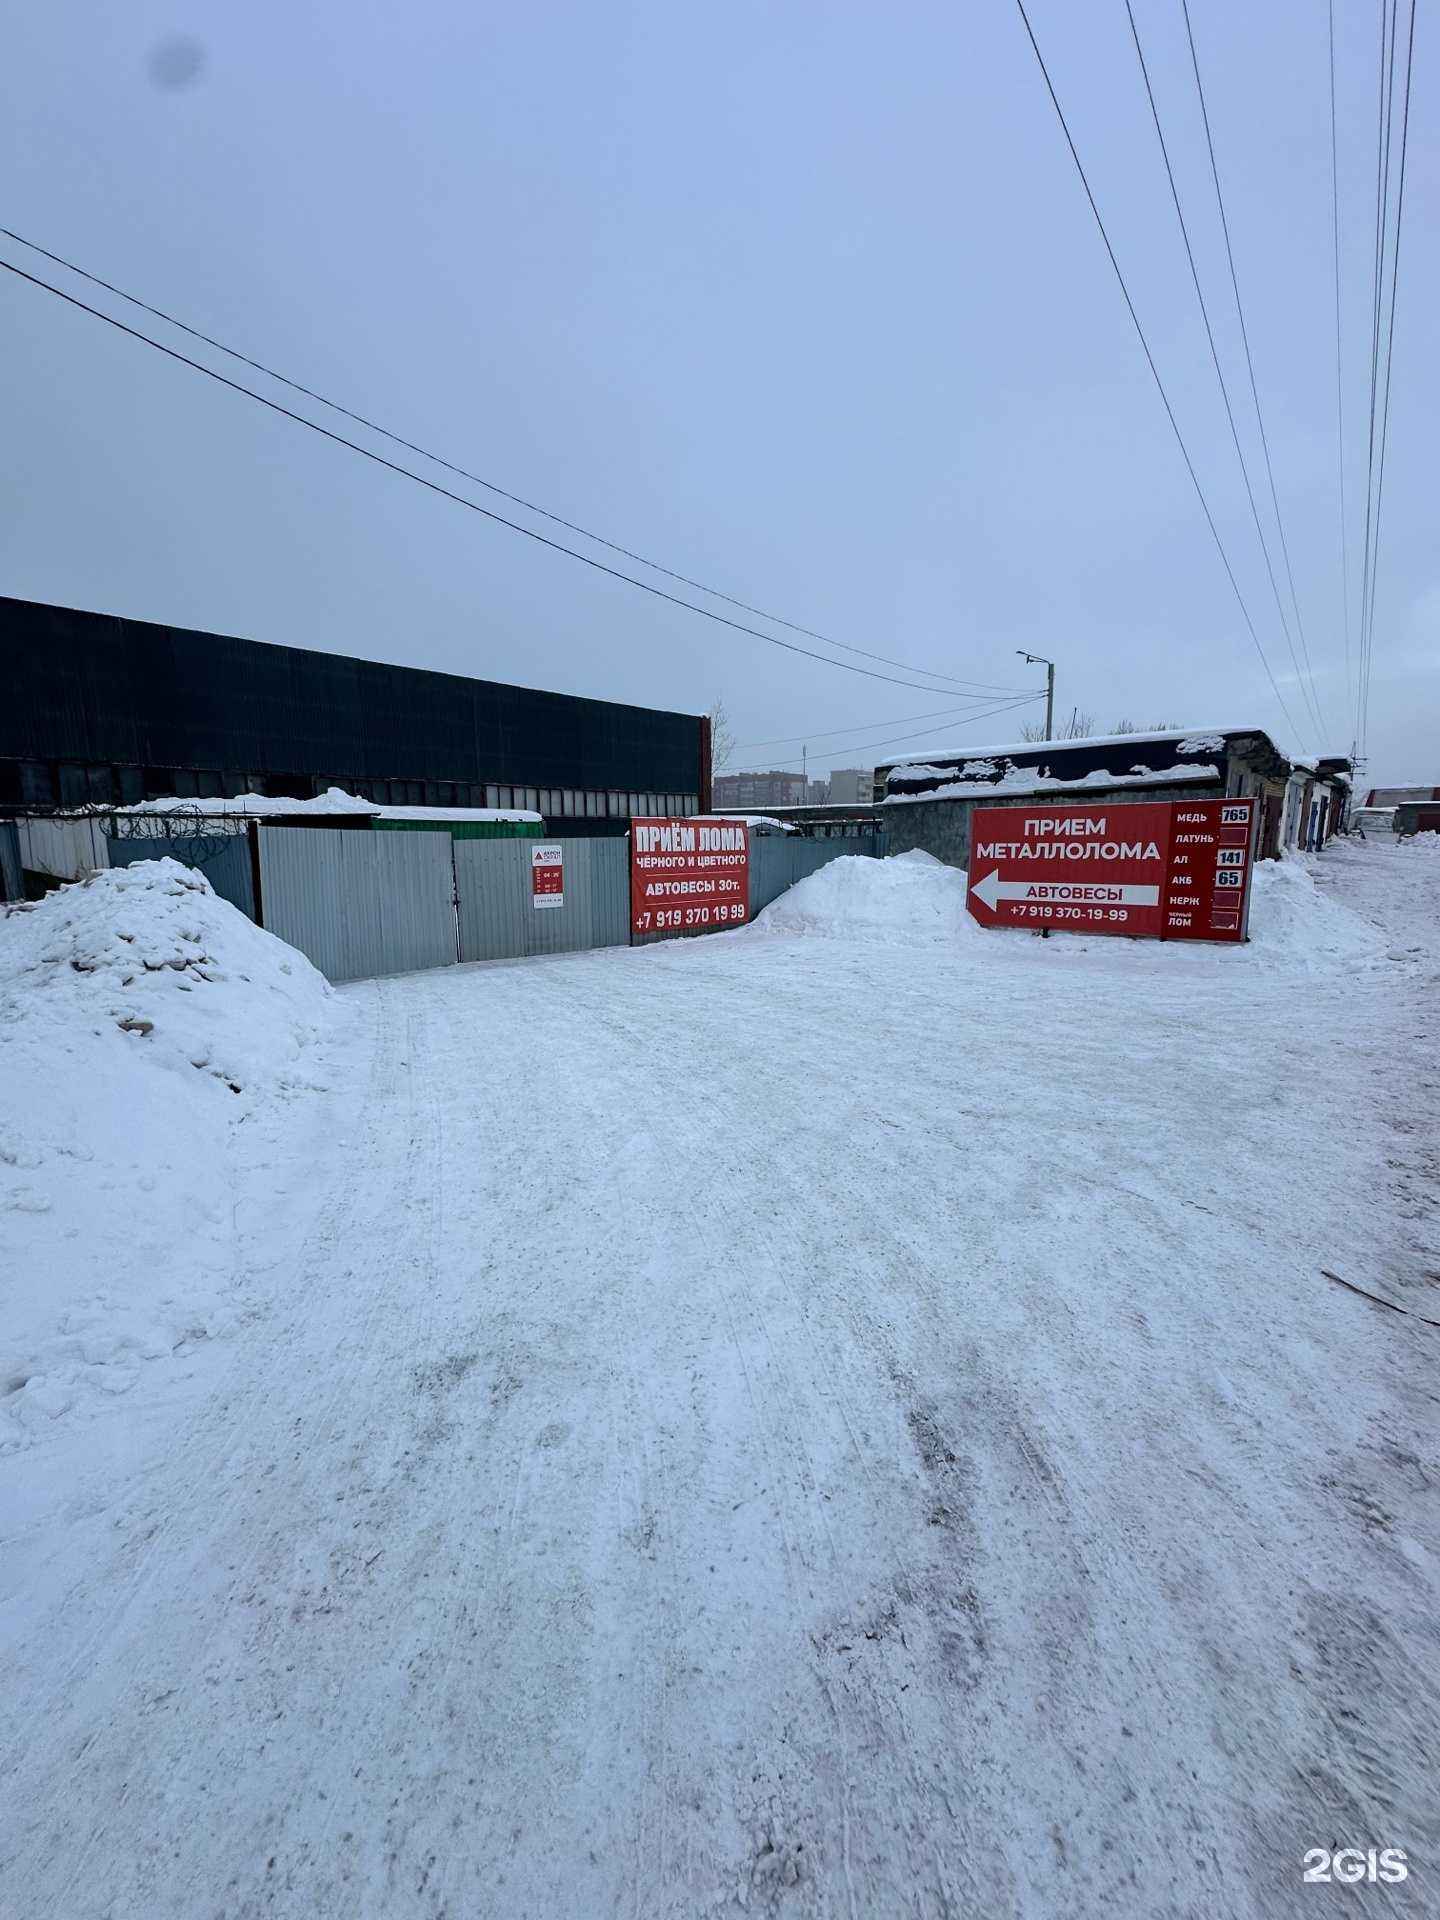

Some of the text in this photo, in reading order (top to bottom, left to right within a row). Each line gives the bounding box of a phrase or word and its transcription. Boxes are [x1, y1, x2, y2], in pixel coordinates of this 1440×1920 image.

[1177, 809, 1248, 823] МЕДЬ 765
[1024, 818, 1106, 836] ПРИЕМ
[636, 823, 745, 852] ПРИЁМ ЛОМА
[1176, 835, 1214, 843] ЛАТУНЬ
[977, 842, 1160, 860] МЕТАЛЛОЛОМА
[1174, 852, 1240, 864] АЛ 141
[637, 855, 746, 868] ЧЁРНОГО И ЦВЕТНОГО
[1219, 872, 1239, 885] 65
[645, 880, 740, 896] АВТОВЕСЫ 30т.
[1026, 886, 1123, 900] АВТОВЕСЫ
[1169, 897, 1200, 905] НЕРЖ
[636, 904, 745, 928] +7 919 370 19 99
[1010, 906, 1128, 921] +7 919 370-19-99
[1168, 918, 1191, 926] ЛОМ
